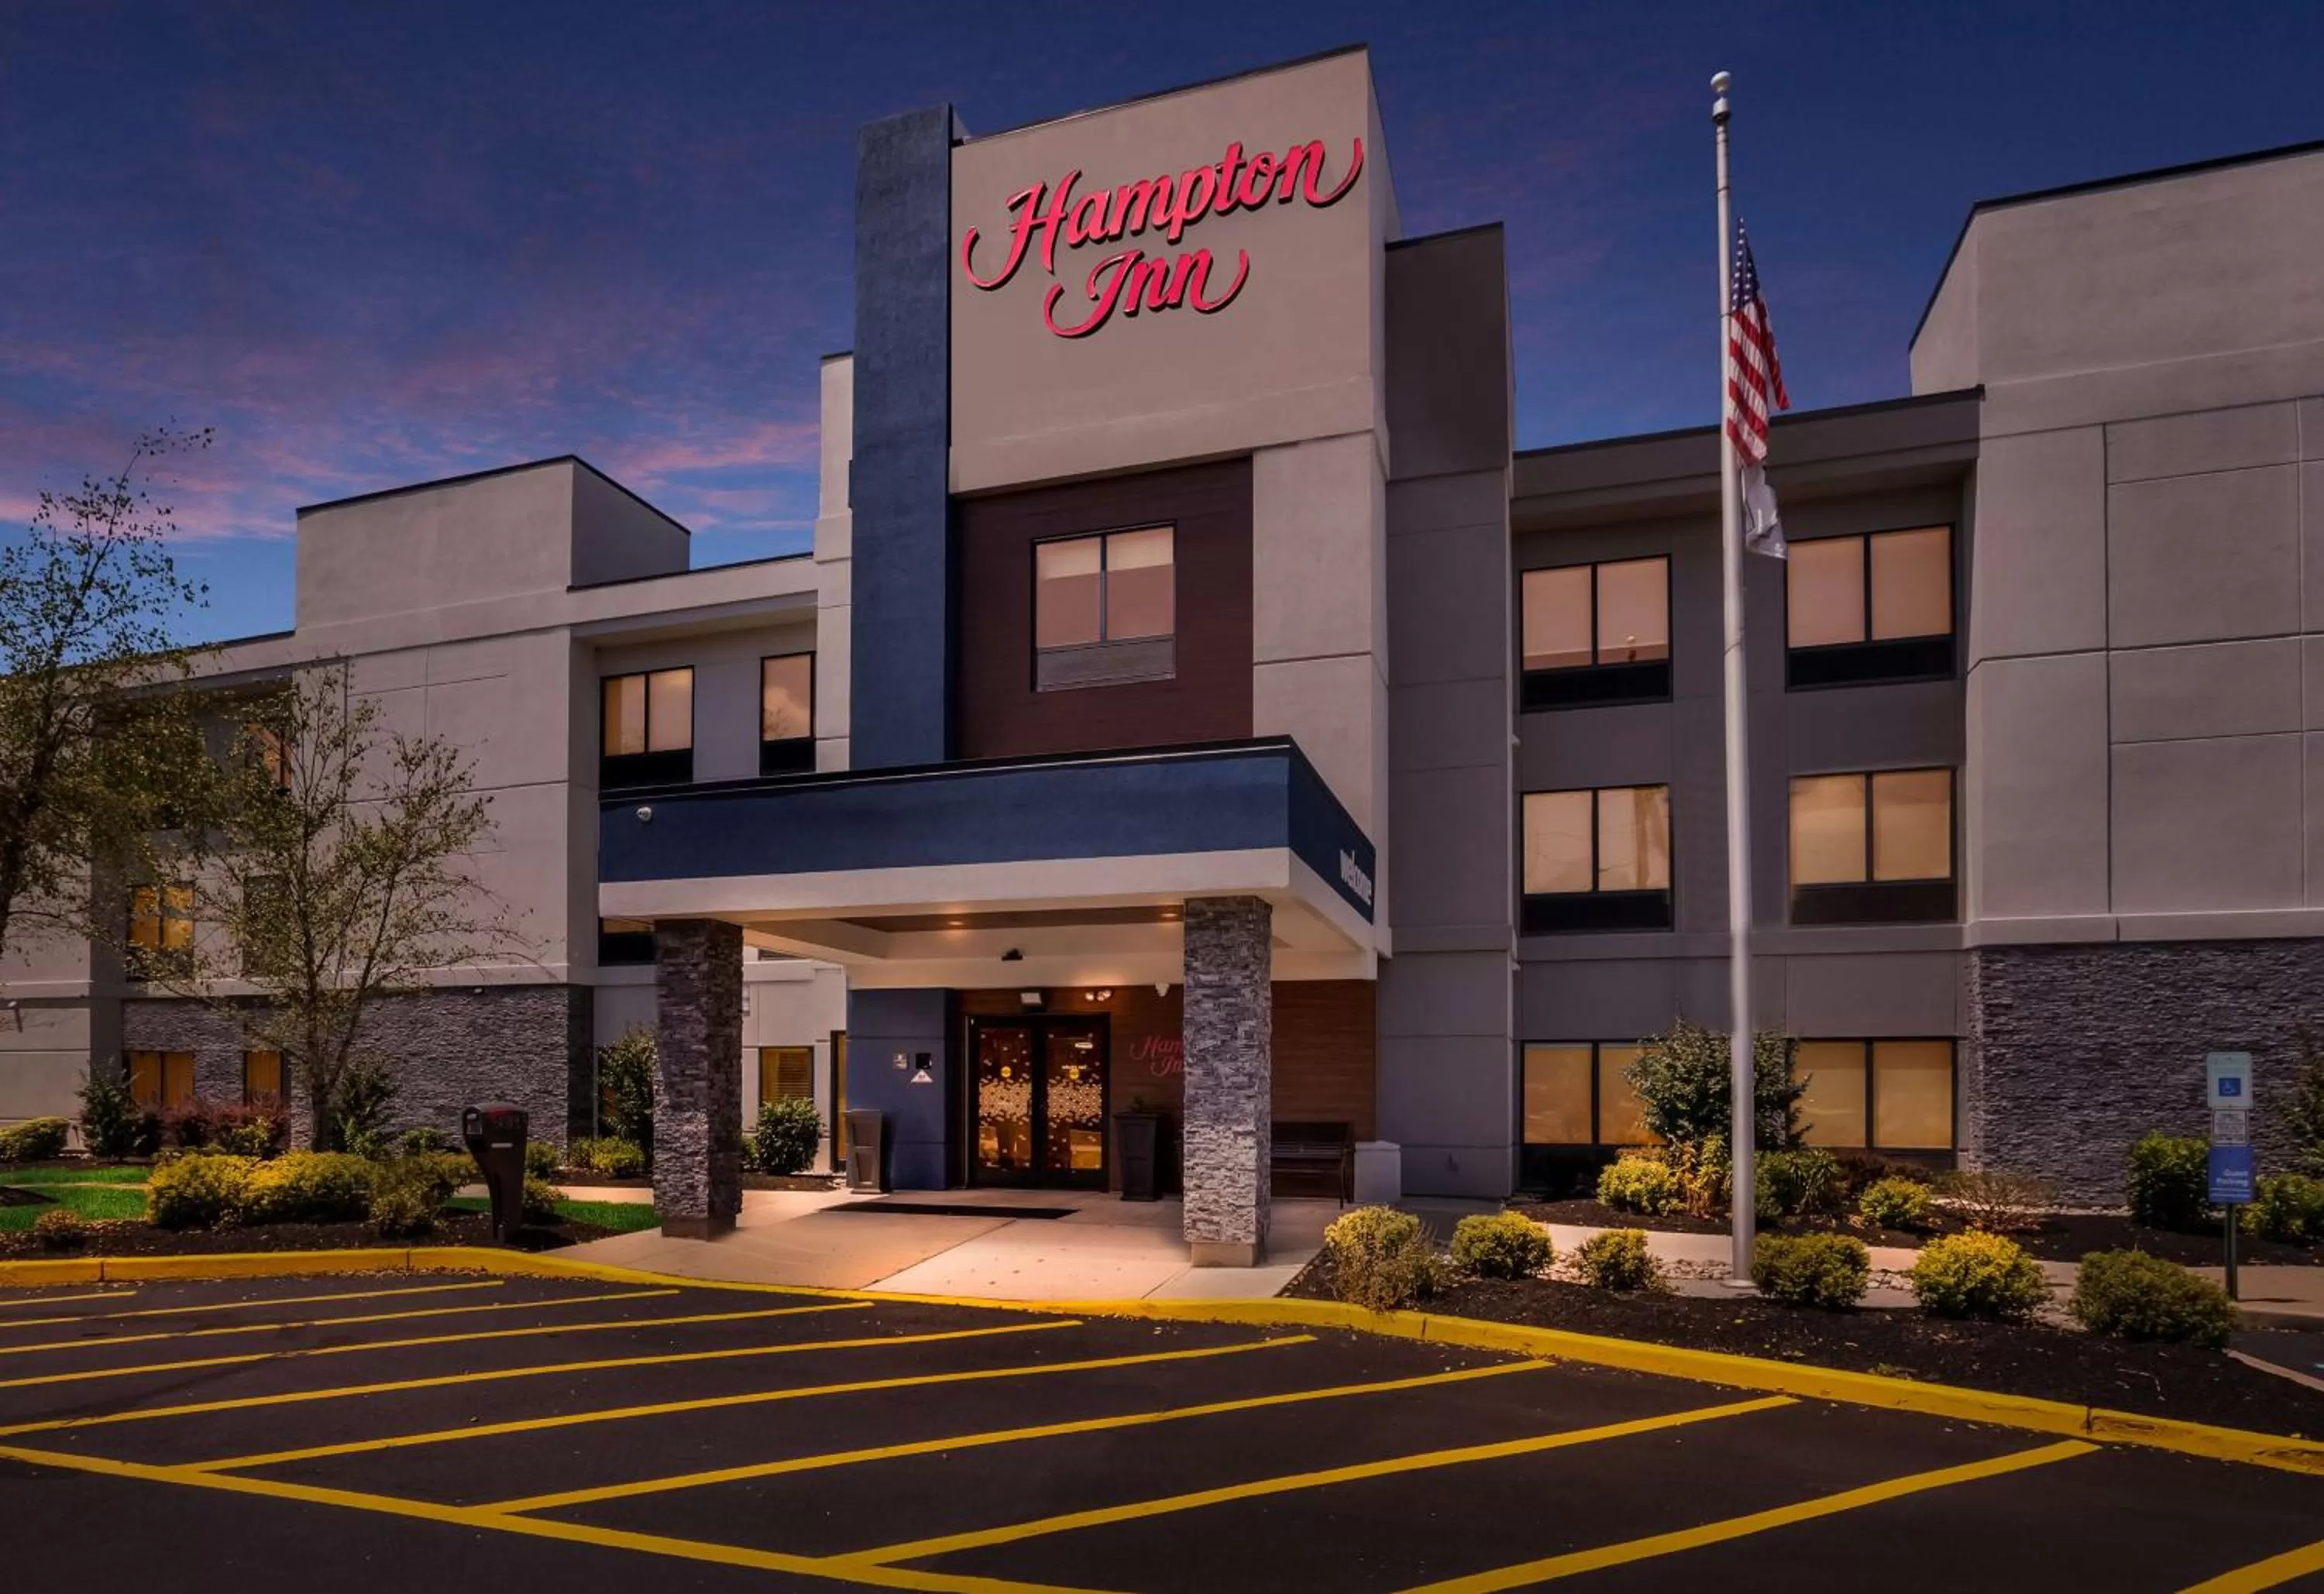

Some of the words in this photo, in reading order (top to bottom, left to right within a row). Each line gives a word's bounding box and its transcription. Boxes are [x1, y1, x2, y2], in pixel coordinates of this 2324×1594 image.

[961, 136, 1364, 289] Hampton
[1043, 248, 1250, 338] Inn
[1150, 1056, 1184, 1077] In
